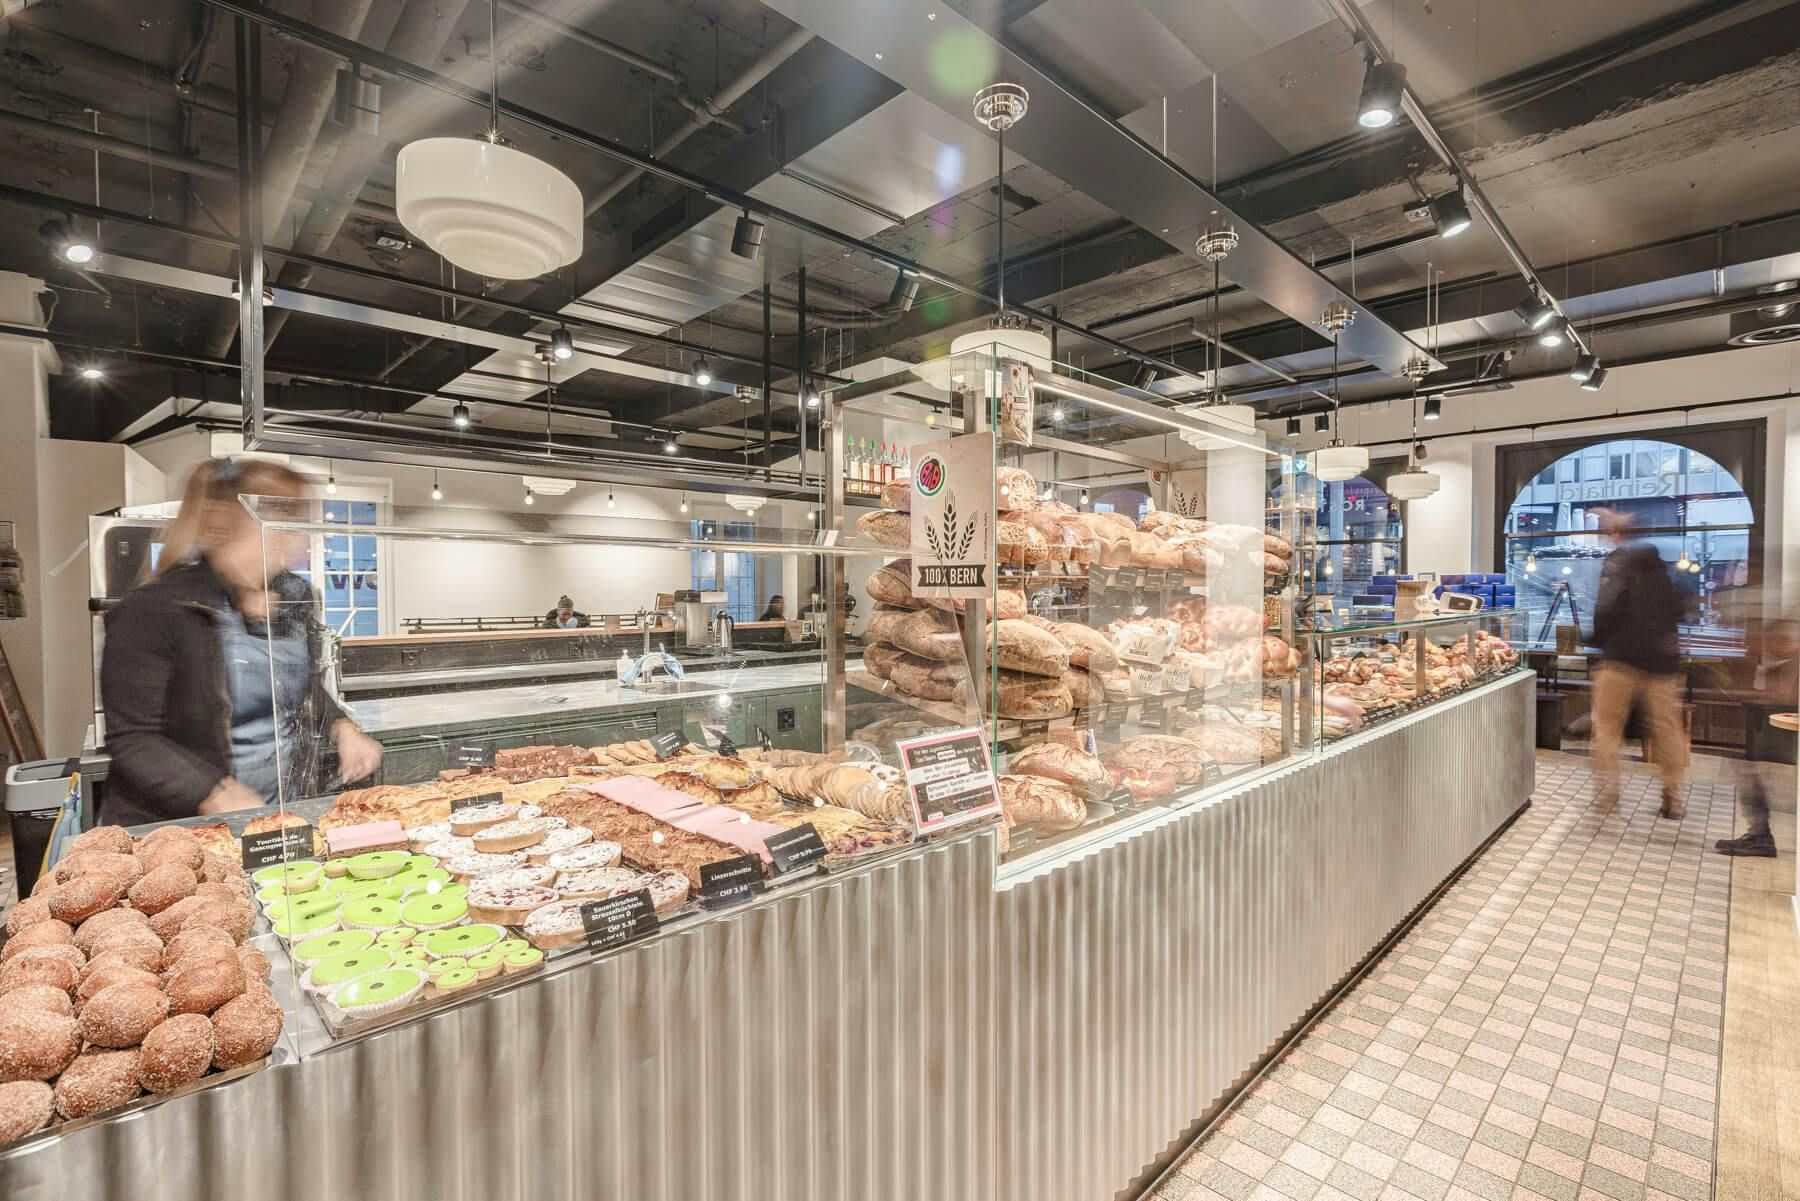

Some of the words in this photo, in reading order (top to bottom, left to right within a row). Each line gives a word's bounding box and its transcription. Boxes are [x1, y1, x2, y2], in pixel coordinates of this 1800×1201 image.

[950, 567, 978, 585] BERN
[256, 836, 288, 846] Tourtièe
[262, 855, 277, 863] CHF
[278, 852, 295, 860] 470
[711, 866, 752, 881] Linzerschnitte
[720, 888, 732, 897] CHF
[593, 896, 639, 913] Sauerkirschen
[608, 924, 620, 933] CHF
